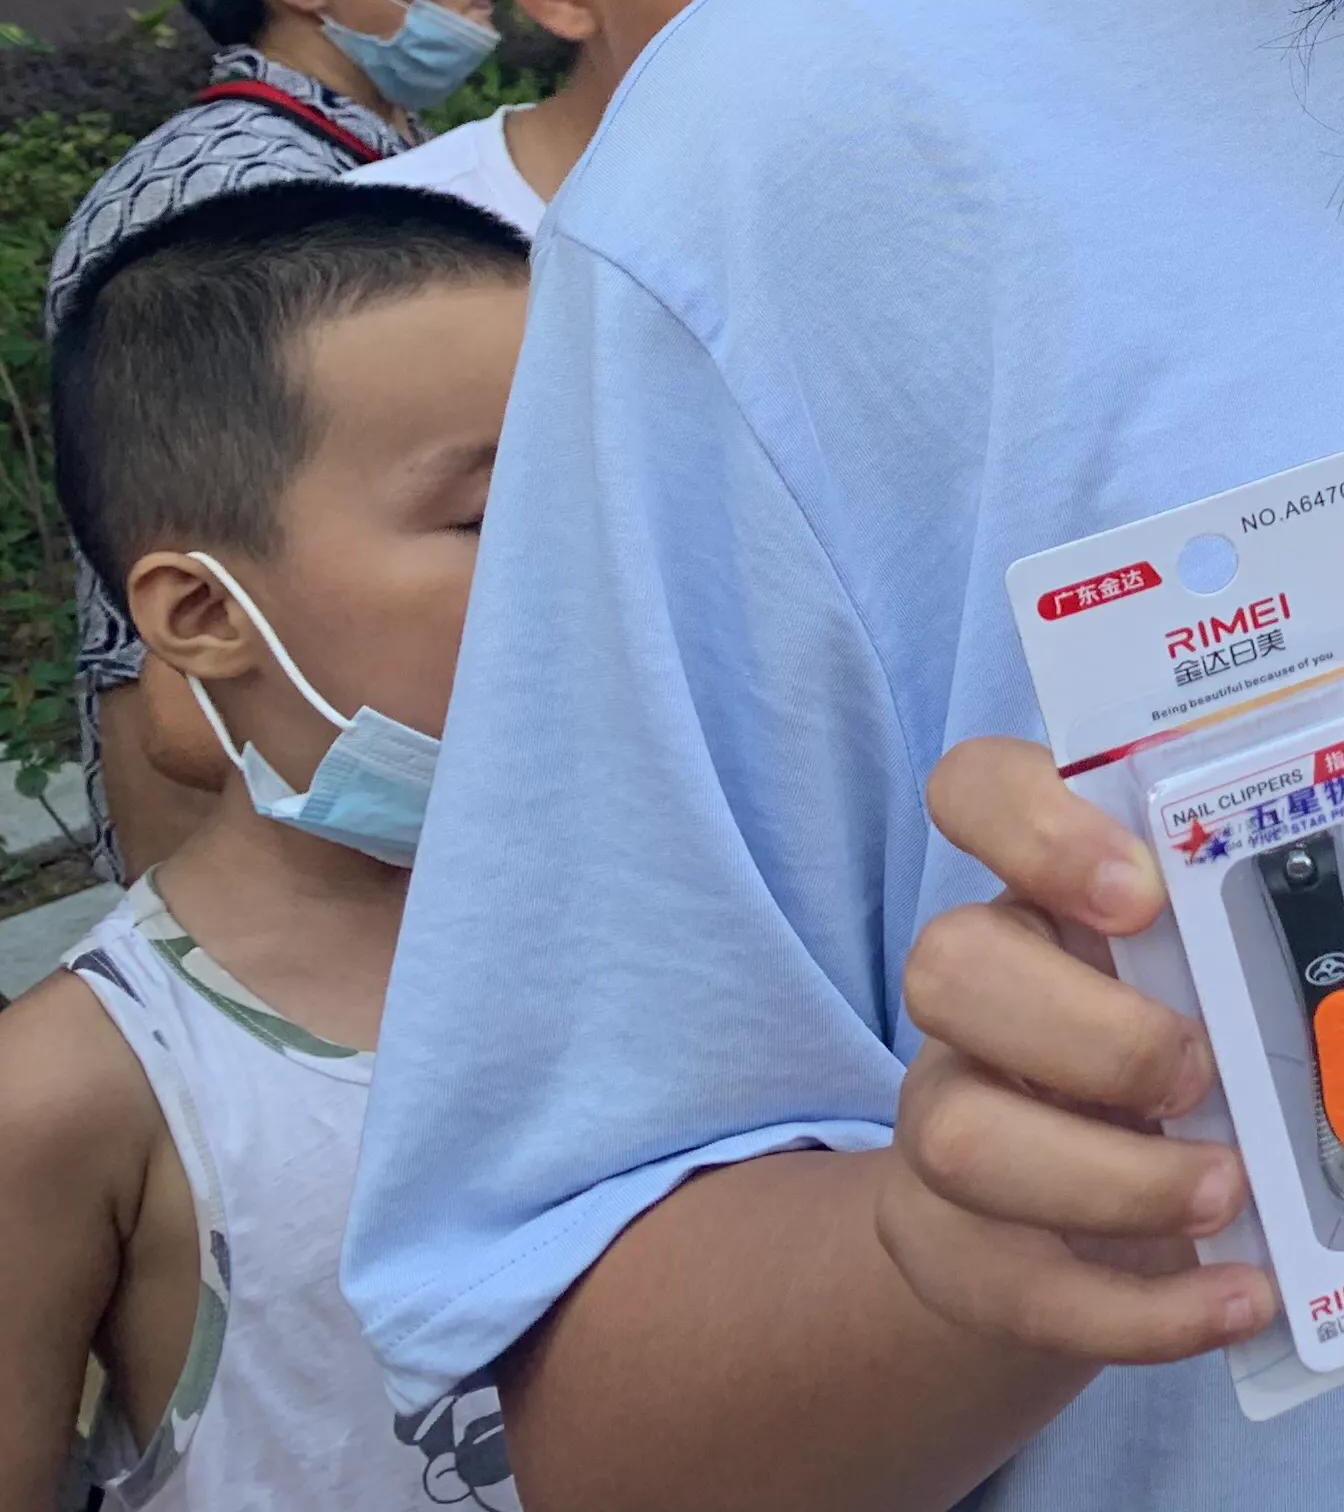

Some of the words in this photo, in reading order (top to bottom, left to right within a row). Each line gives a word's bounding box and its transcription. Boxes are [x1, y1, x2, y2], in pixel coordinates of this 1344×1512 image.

[1053, 568, 1145, 614] 广东金达
[1165, 592, 1291, 659] RIMEI
[1152, 702, 1187, 721] Being
[1189, 682, 1243, 707] beautiful
[1244, 665, 1295, 689] because
[1299, 657, 1309, 670] of
[1312, 652, 1334, 667] you
[1173, 629, 1286, 687] 金达日美
[1172, 802, 1215, 826] NAIL
[1218, 769, 1303, 810] CLIPPERS
[1291, 810, 1327, 833] STAR
